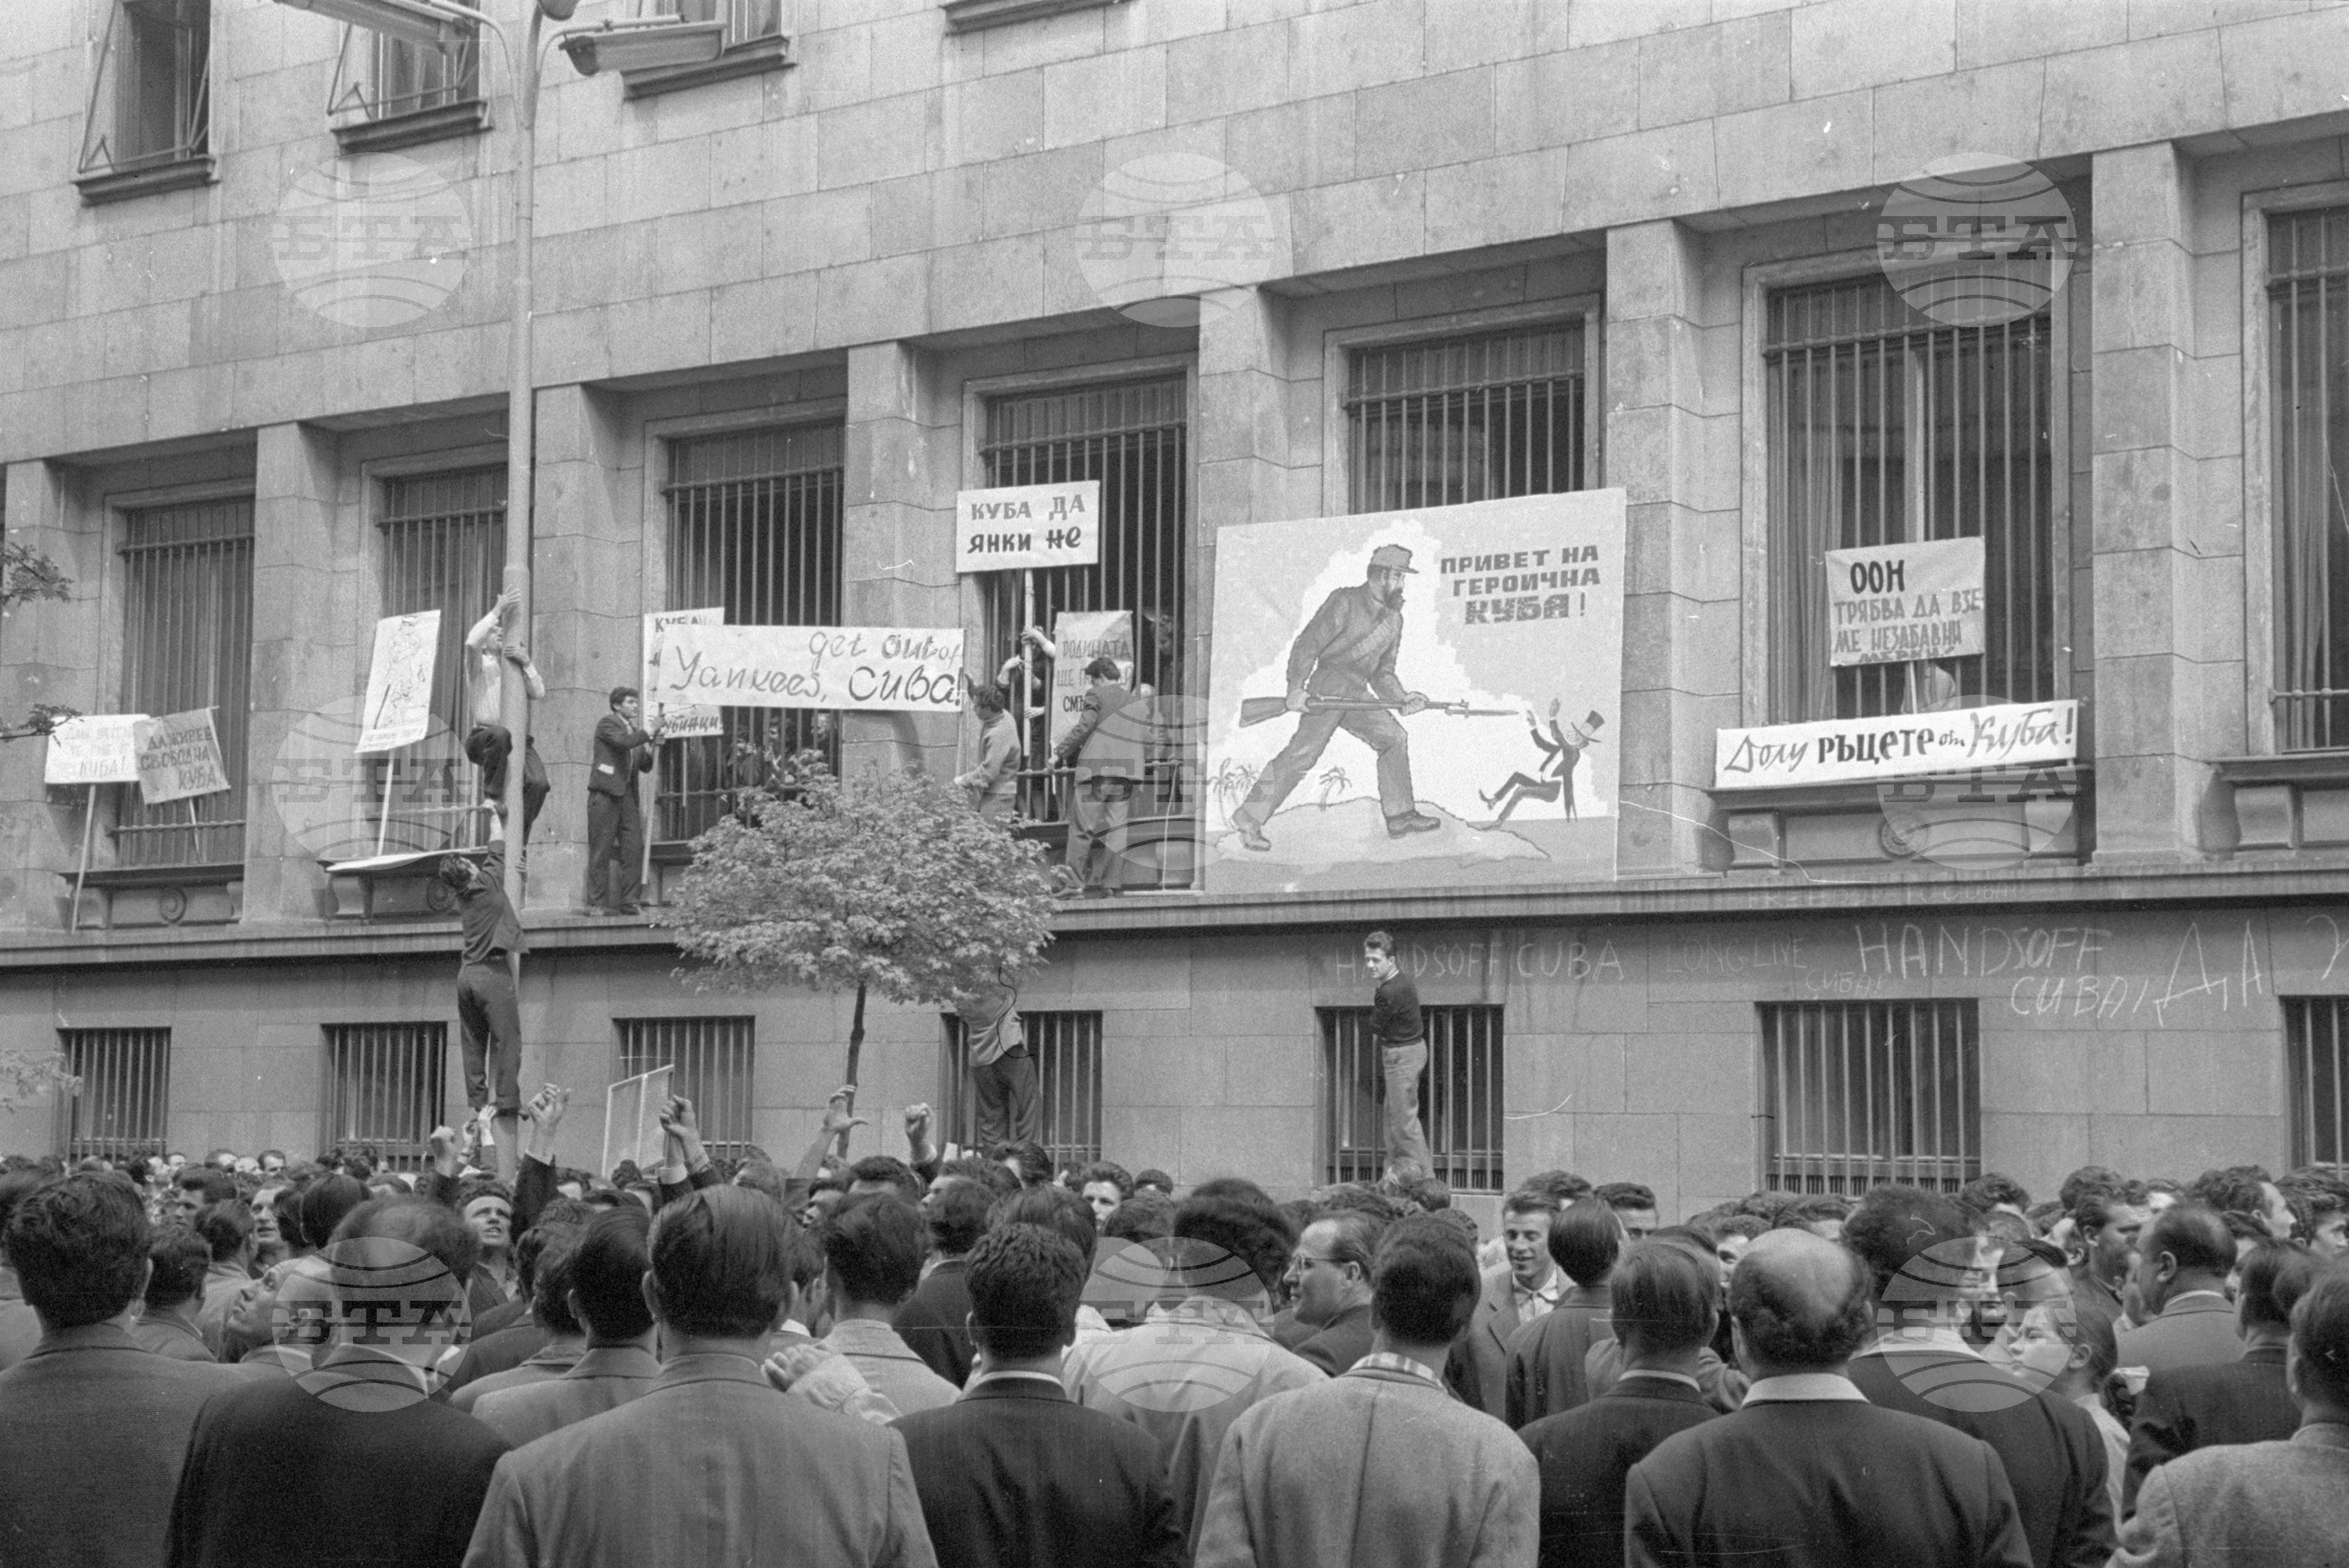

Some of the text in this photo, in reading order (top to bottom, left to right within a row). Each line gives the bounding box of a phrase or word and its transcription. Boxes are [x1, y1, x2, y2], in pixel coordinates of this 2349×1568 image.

[971, 494, 1085, 520] КУБА ДА
[967, 533, 1031, 553] ЯНКИ
[1441, 545, 1598, 574] ПРИВЕТ НА
[1453, 567, 1600, 596] ГЕРОИЧНА
[1850, 559, 1905, 594] ООН
[1833, 597, 1905, 625] ТРЯБВА
[1912, 594, 1941, 618] ДА
[809, 631, 867, 673] get
[1835, 620, 1962, 654] МЕ НЕЗАБАВНИ
[669, 645, 827, 703] Yankees,
[1724, 735, 1808, 773] Долу
[1966, 706, 2074, 761] Куба!
[1517, 940, 1624, 983] CUBA
